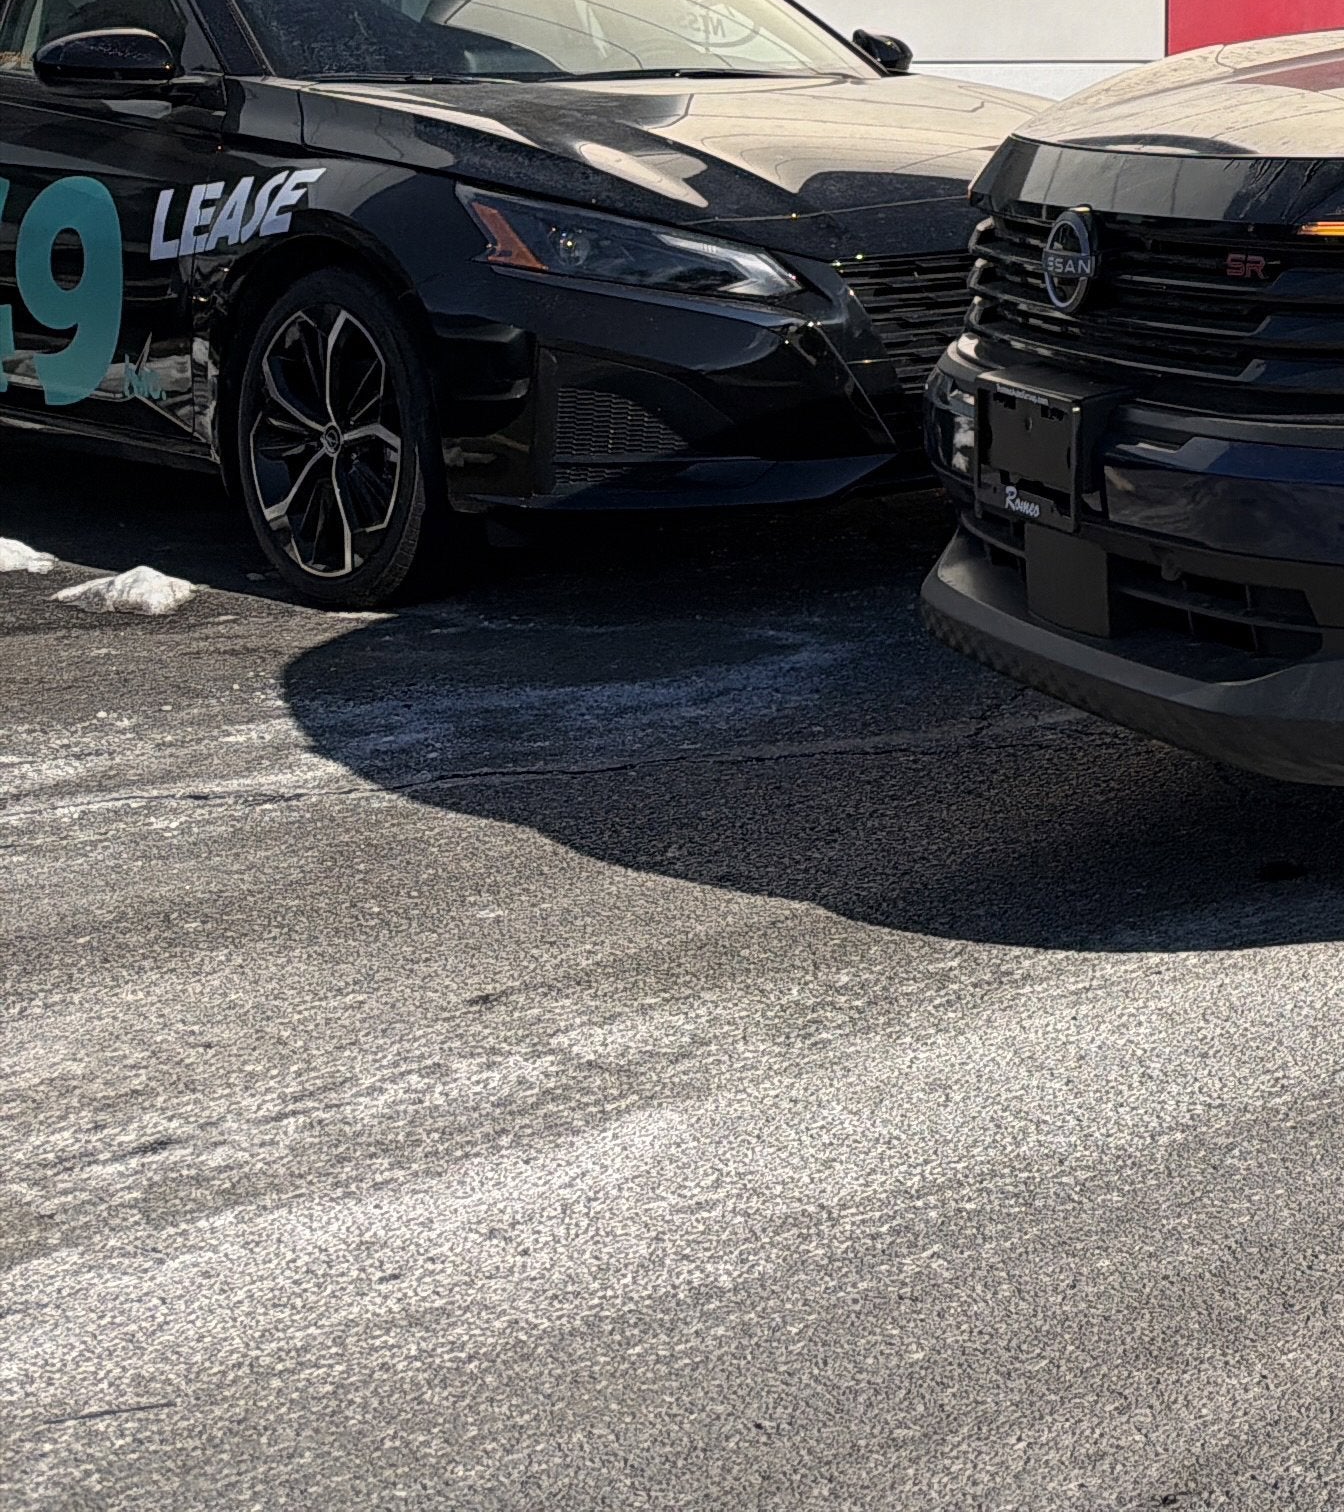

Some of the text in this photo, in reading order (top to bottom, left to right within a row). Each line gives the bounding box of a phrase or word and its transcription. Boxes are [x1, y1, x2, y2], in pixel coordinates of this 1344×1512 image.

[150, 167, 327, 261] LEASE
[0, 176, 124, 406] 9
[1226, 252, 1269, 280] SR
[1004, 485, 1041, 518] Romeo
